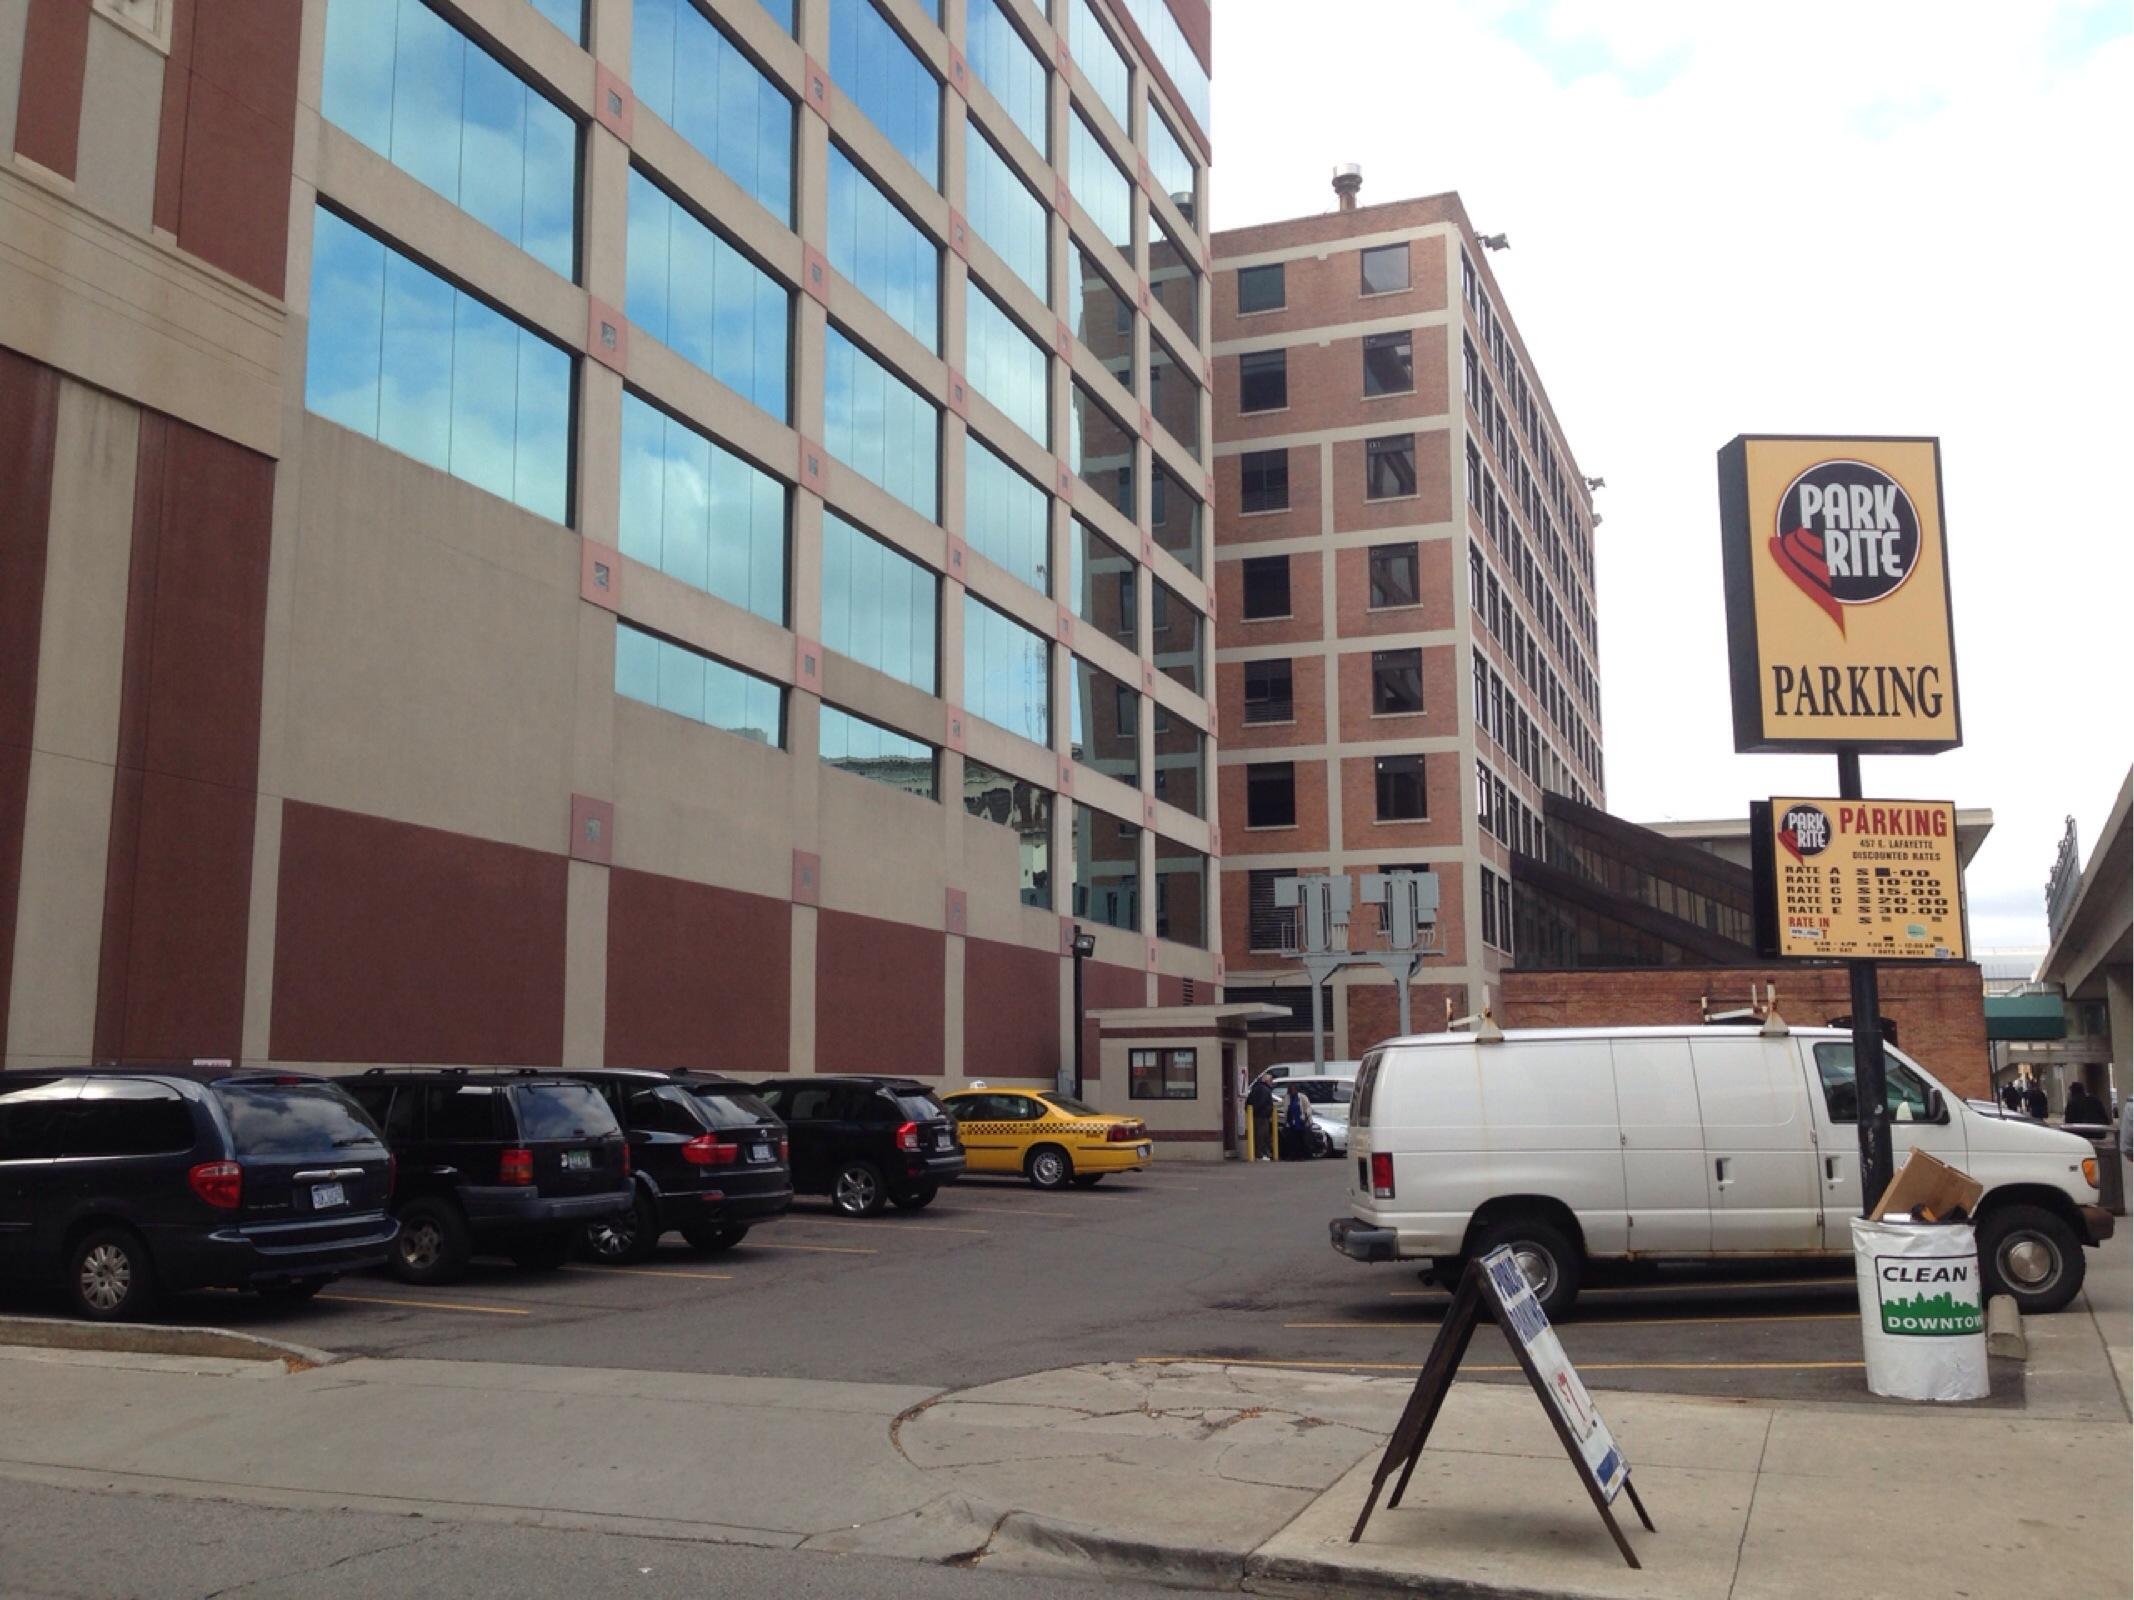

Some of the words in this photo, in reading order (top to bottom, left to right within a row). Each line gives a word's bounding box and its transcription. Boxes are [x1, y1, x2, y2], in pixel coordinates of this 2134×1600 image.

[1799, 483, 1900, 530] PARK
[1824, 529, 1904, 577] RITE
[1771, 664, 1943, 719] PARKING
[1787, 812, 1826, 831] PARK
[1839, 807, 1948, 837] PARKING
[1797, 830, 1826, 848] RITE
[1889, 839, 1933, 849] LAFAYETTE
[1852, 851, 1909, 861] DISCOUNTED
[1912, 852, 1941, 861] RATES
[1785, 866, 1819, 874] RATE
[1829, 867, 1840, 875] A
[1786, 876, 1821, 884] RATE
[1786, 886, 1821, 894] RATE
[1787, 896, 1822, 904] RATE
[1831, 896, 1842, 904] D
[1788, 906, 1823, 914] RATE
[1788, 916, 1815, 928] RATE
[1819, 917, 1831, 928] IN
[1882, 1266, 1968, 1283] CLEAN
